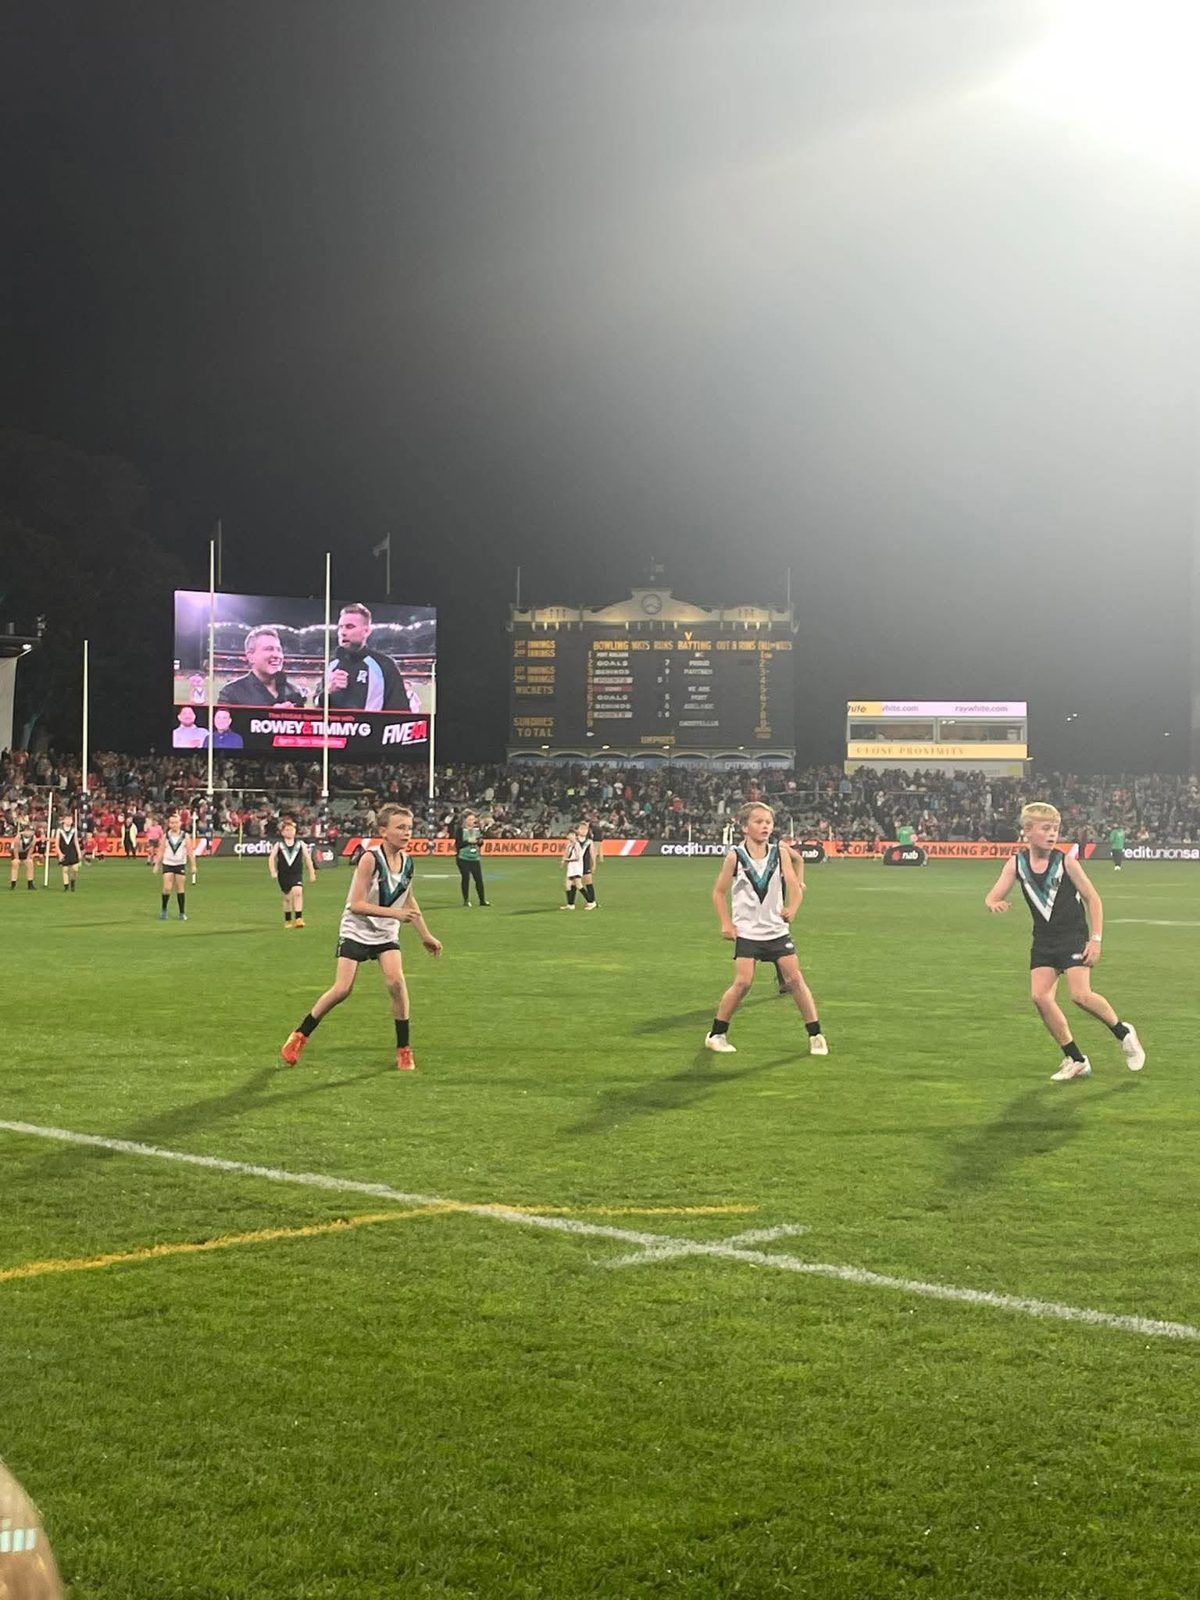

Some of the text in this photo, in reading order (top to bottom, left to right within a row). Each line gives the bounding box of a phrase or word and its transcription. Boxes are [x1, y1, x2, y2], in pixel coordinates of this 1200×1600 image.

[955, 705, 1008, 713] raywhite.com
[516, 728, 554, 738] TOTAL
[485, 843, 539, 853] BANKING
[902, 850, 919, 860] nab
